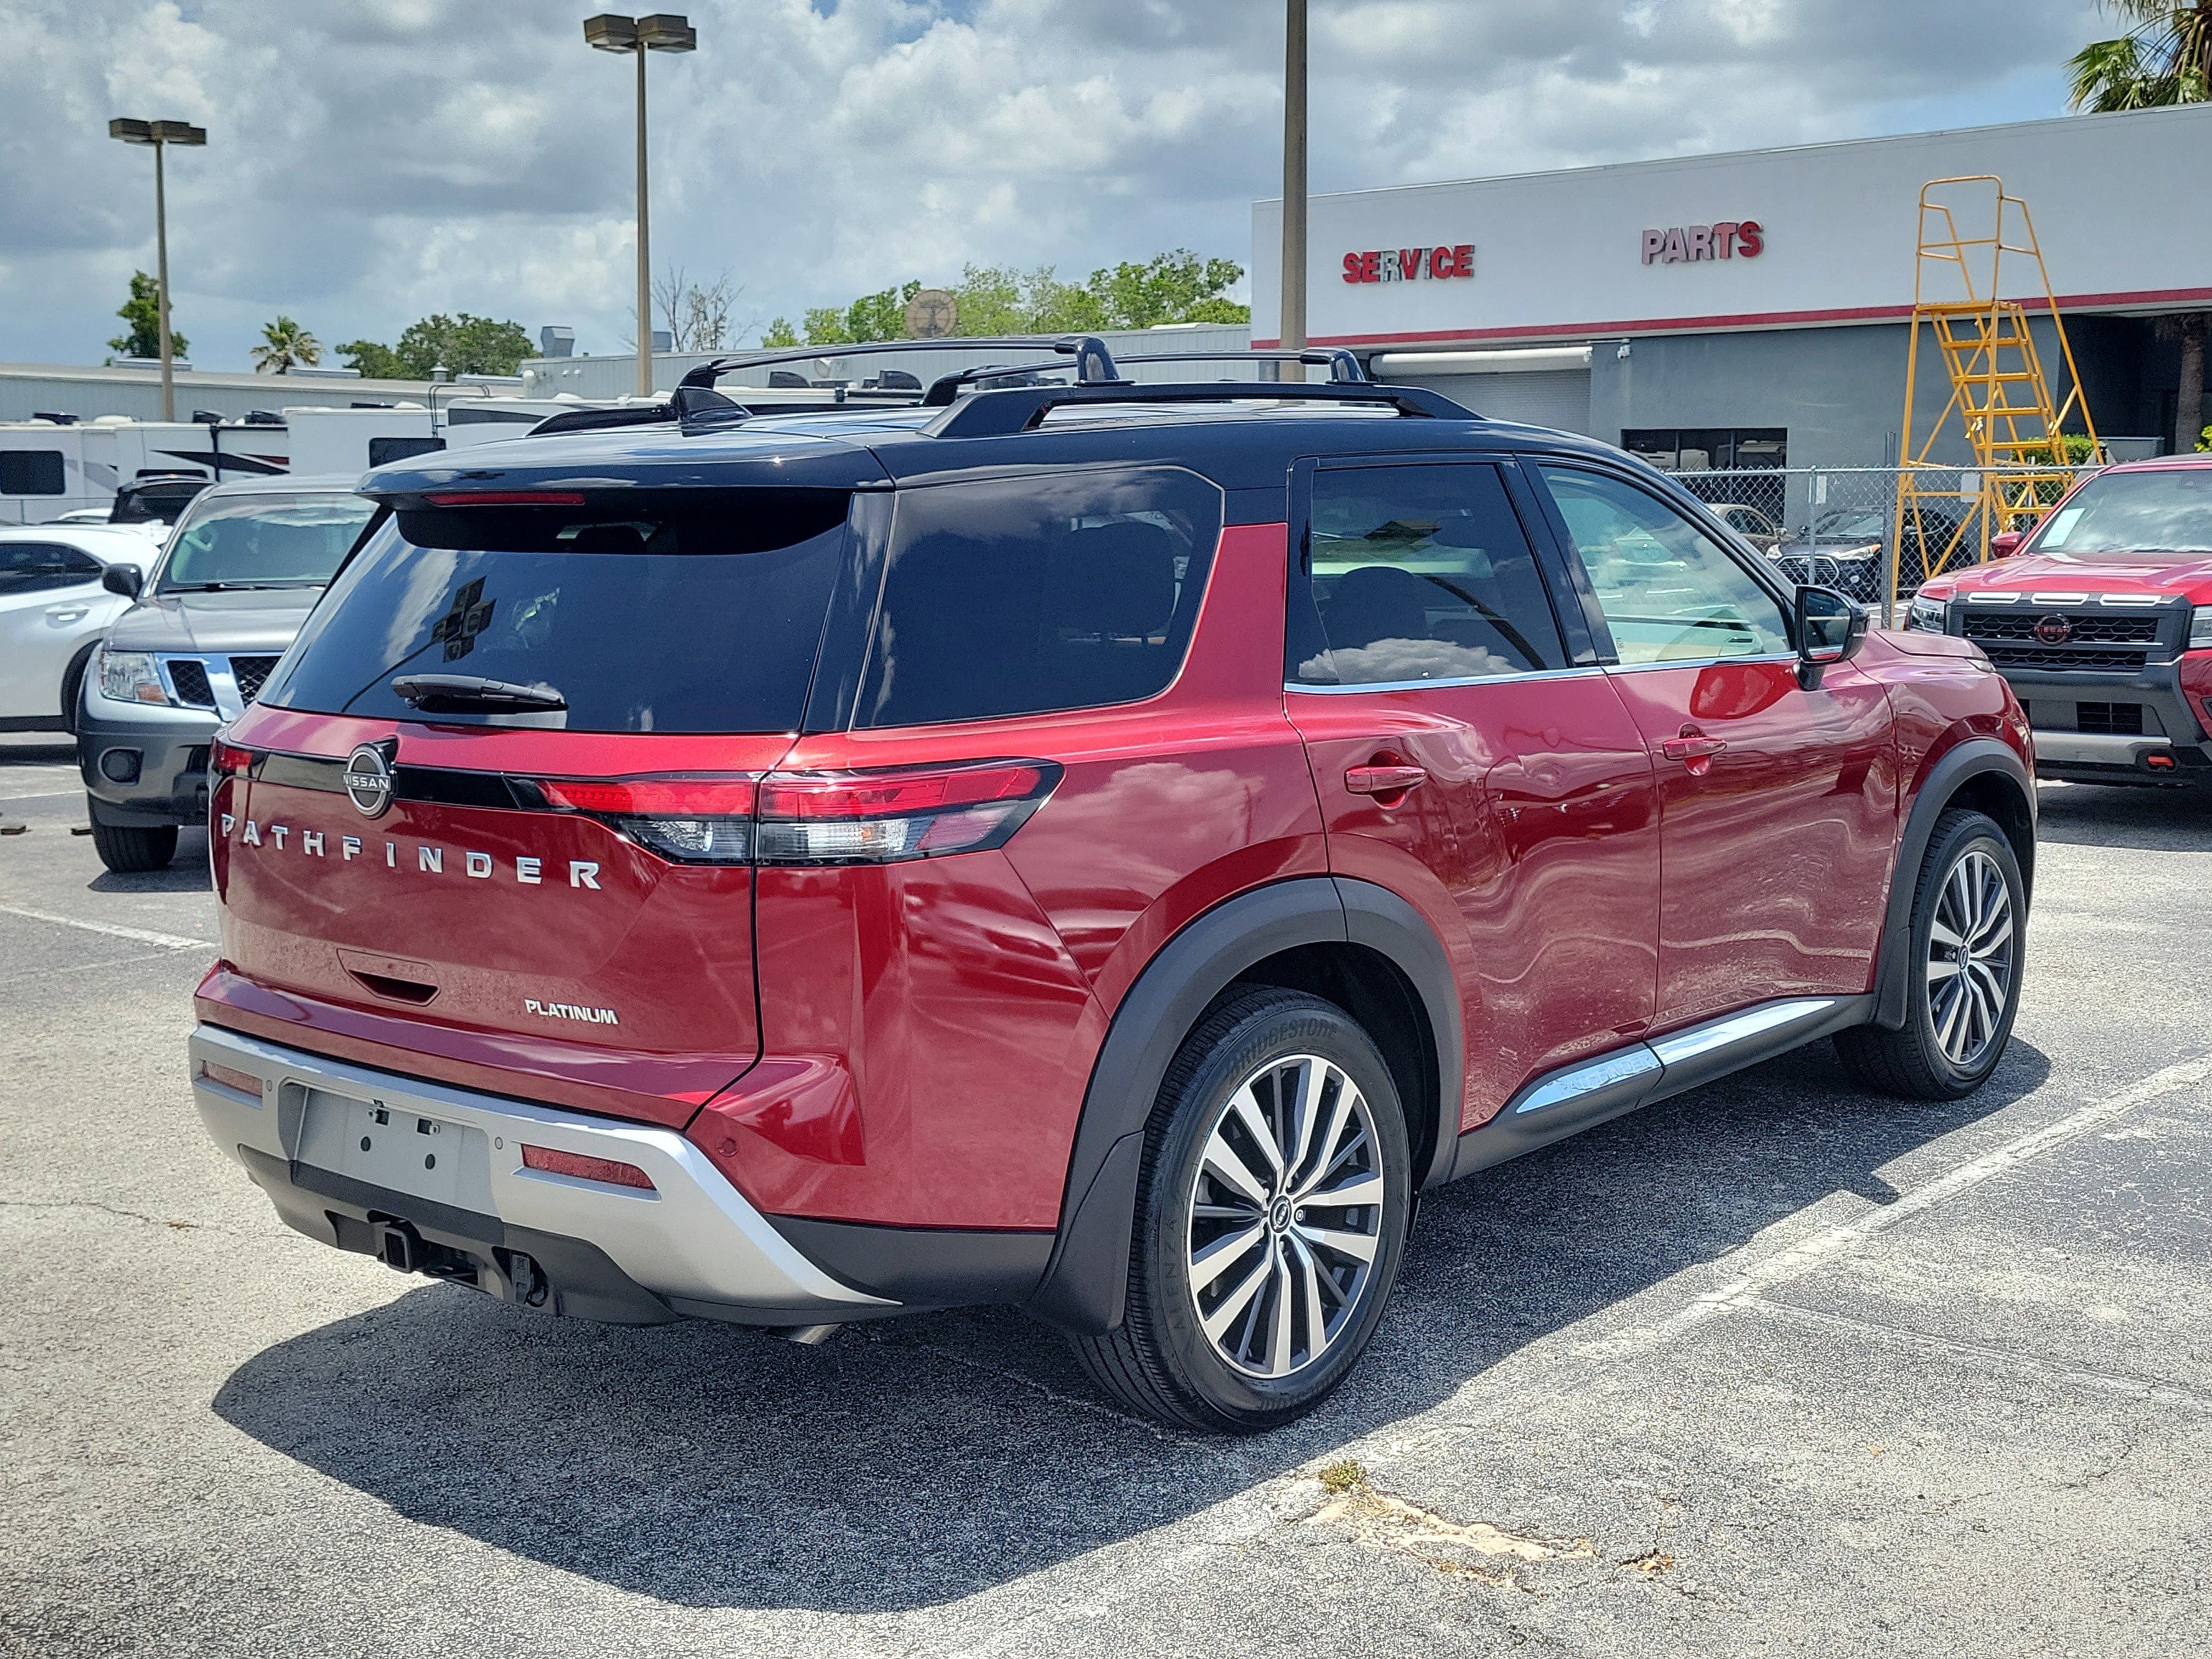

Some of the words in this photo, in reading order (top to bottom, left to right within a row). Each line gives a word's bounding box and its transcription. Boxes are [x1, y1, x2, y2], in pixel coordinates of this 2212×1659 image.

[1642, 221, 1764, 264] PARTS
[1342, 245, 1475, 284] SERVICE
[343, 774, 389, 789] NISSAN
[221, 813, 602, 890] PATHFINDER
[524, 999, 619, 1025] PLATINUM
[1562, 1054, 1652, 1093] PATHFINDER
